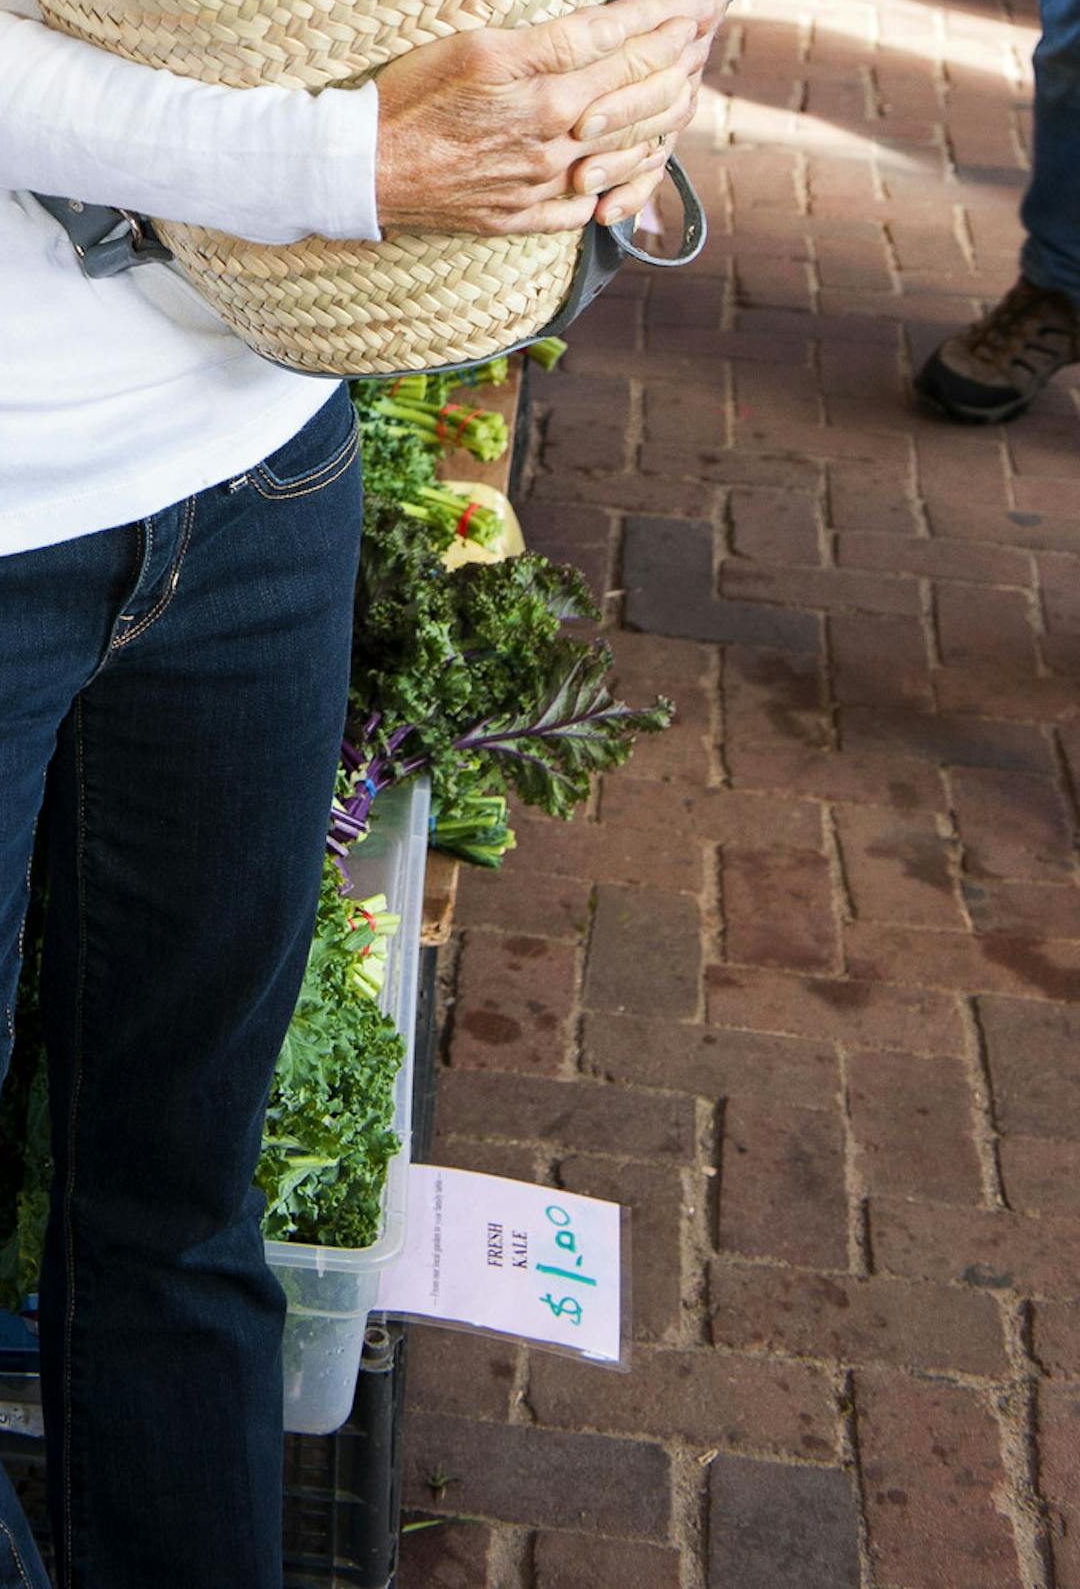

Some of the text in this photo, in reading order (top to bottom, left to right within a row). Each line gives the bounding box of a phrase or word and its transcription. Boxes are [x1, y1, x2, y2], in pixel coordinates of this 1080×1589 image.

[487, 1222, 504, 1268] FRESH
[512, 1230, 528, 1269] KALE
[536, 1205, 598, 1326] $1.00
